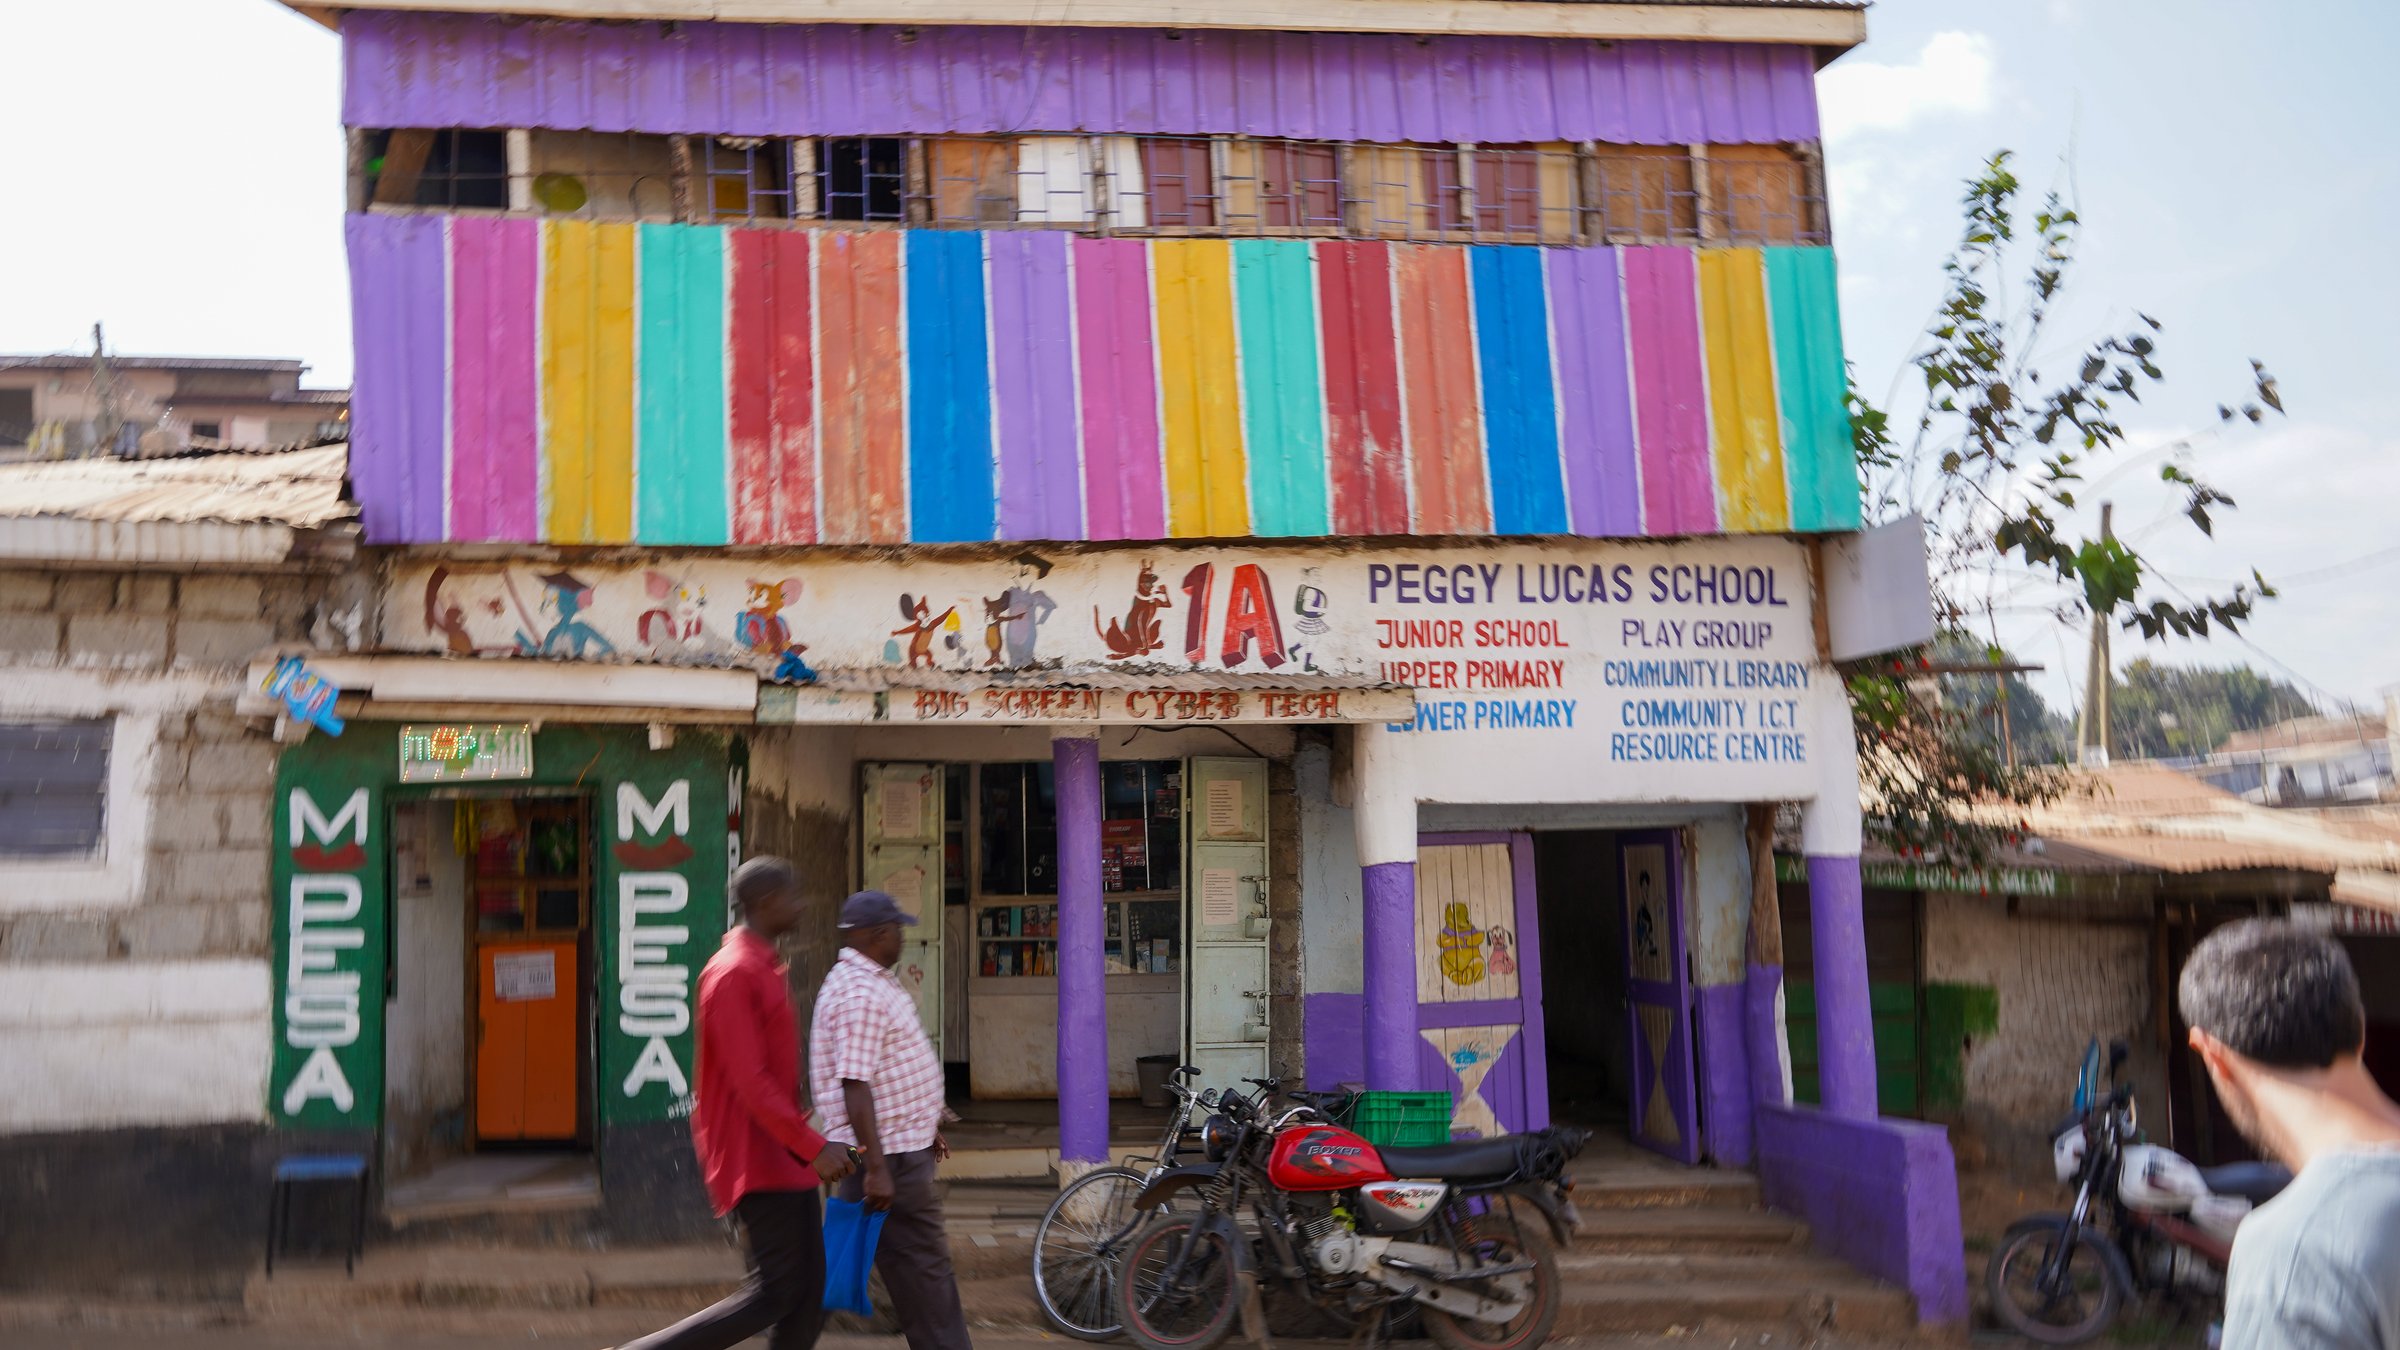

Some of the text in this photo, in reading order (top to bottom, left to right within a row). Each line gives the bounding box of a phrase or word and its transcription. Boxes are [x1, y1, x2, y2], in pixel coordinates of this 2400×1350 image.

[1368, 563, 1788, 606] PEGGY LUCAS SCHOOL
[1181, 562, 1286, 669] 1A
[1375, 619, 1569, 648] JUNIOR SCHOOL
[1621, 619, 1773, 649] PLAY GROUP
[1380, 659, 1565, 689] UPPER PRIMARY
[1604, 659, 1811, 689] COMMUNITY LIBRARY
[913, 688, 1341, 720] BIG SCREEN CYBER TECH
[1386, 699, 1577, 732] WER PRIMARY
[1621, 699, 1747, 728] COMMUNITY
[1611, 732, 1808, 762] RESOURCE CENTRE
[1306, 1145, 1363, 1156] BOXER
